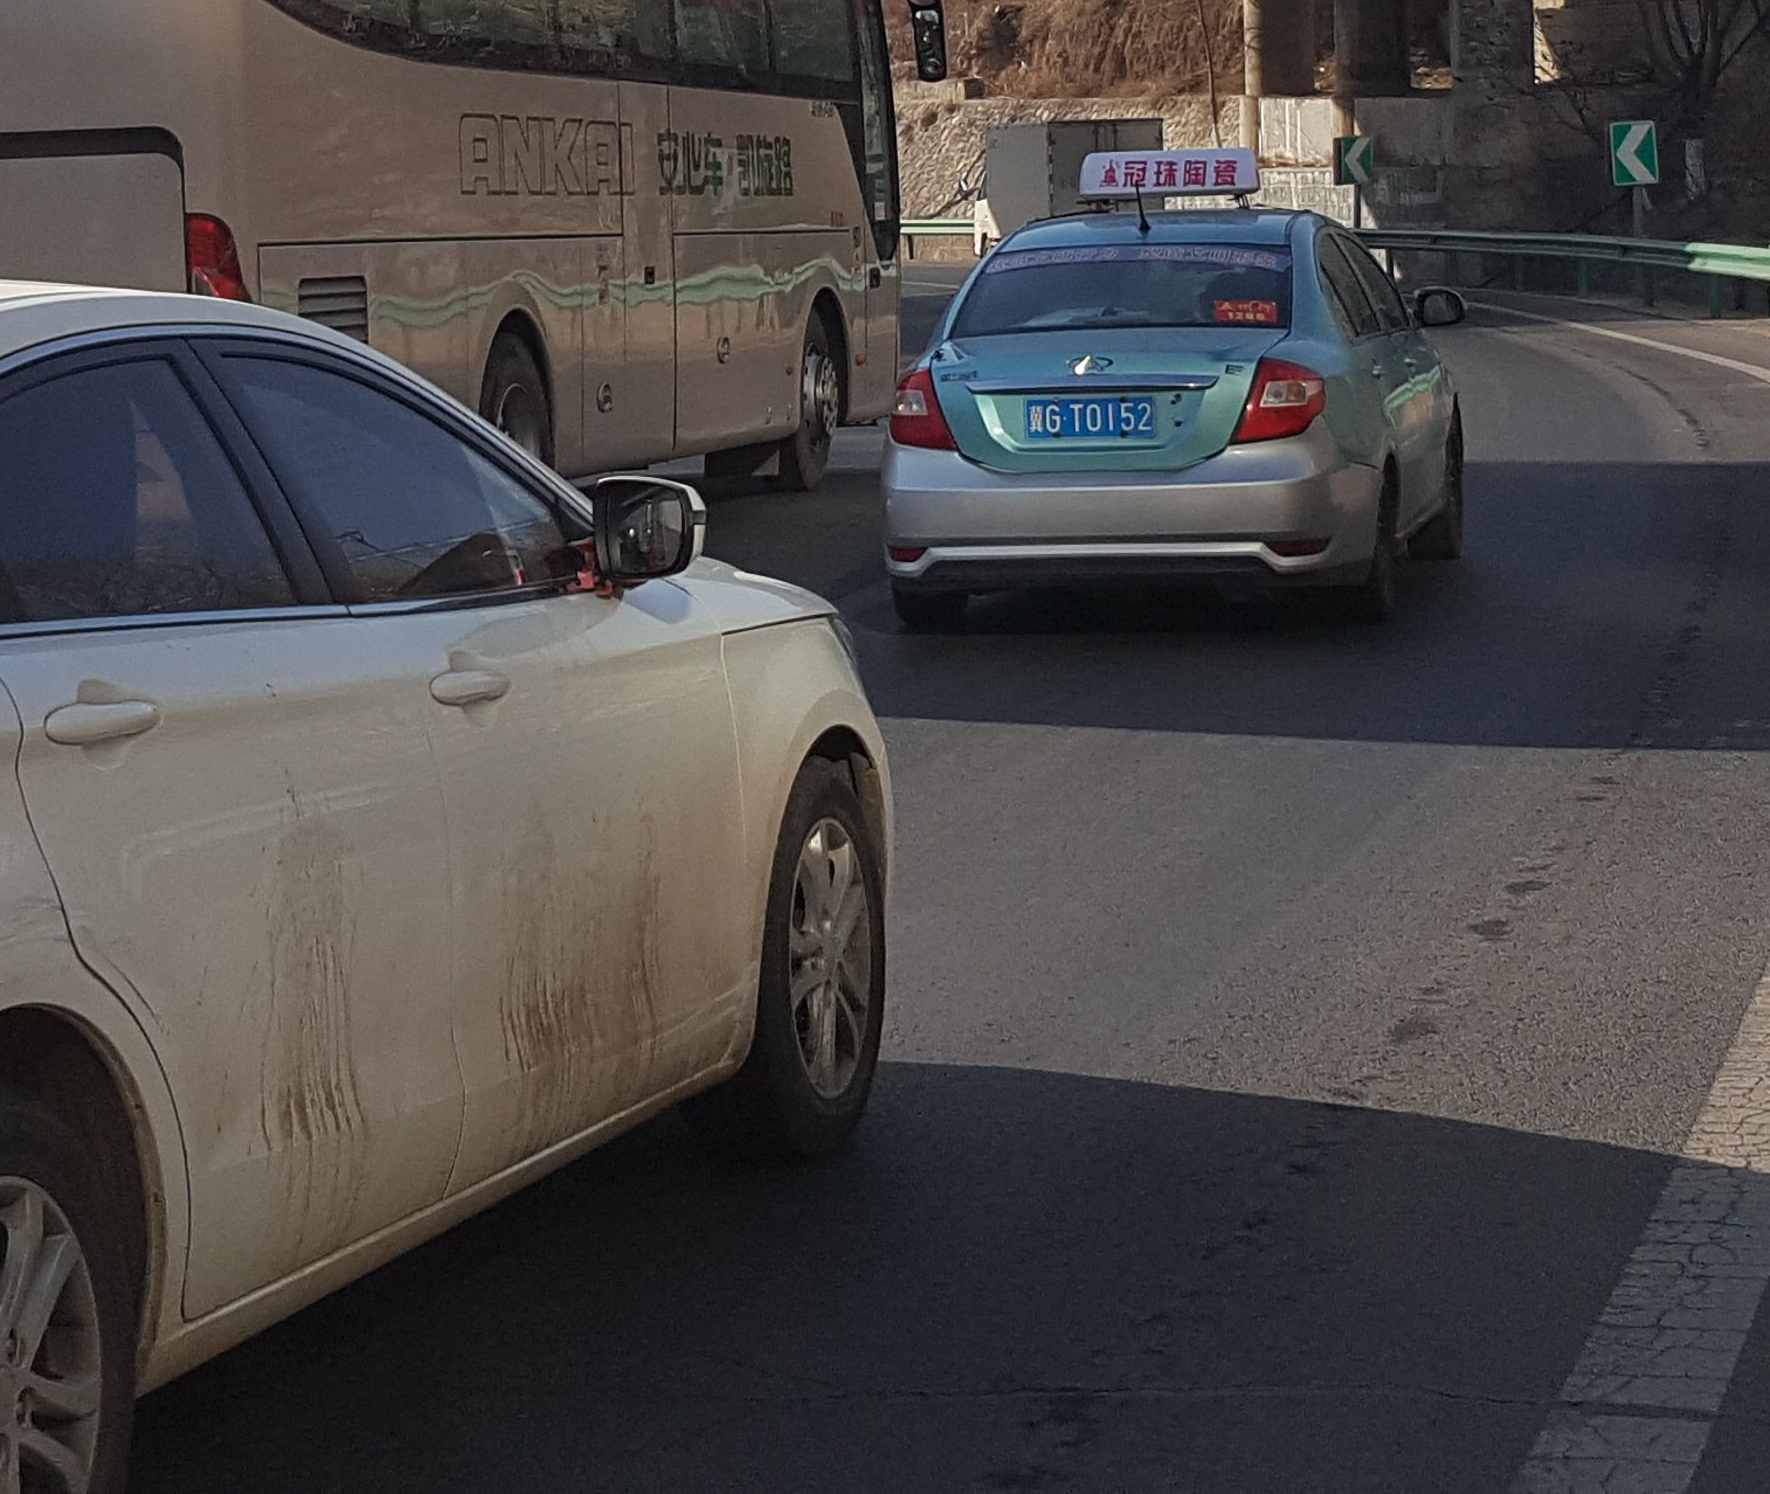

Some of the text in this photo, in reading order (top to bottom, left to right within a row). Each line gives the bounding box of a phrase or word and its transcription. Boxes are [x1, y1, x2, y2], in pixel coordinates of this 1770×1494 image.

[458, 113, 636, 197] ANKAI
[1122, 159, 1238, 188] 冠珠陶瓷
